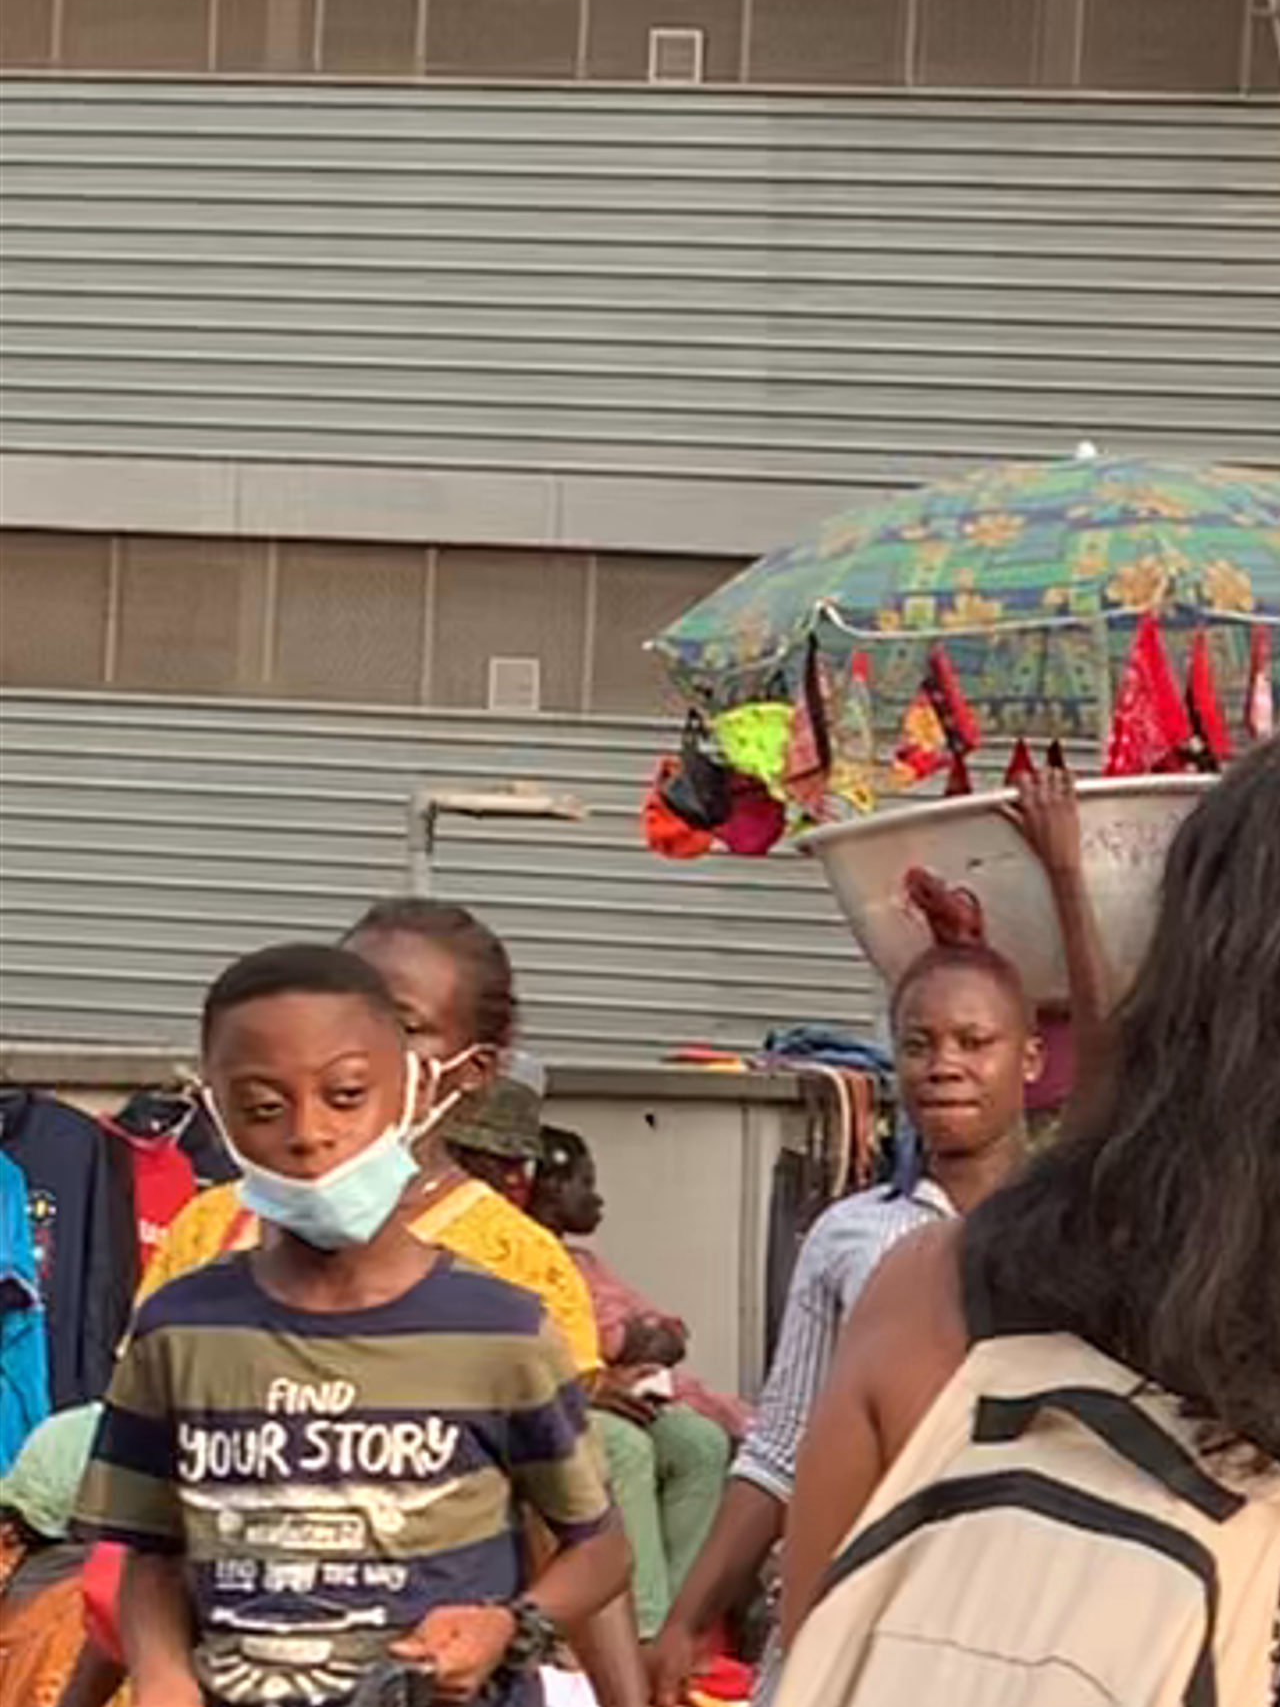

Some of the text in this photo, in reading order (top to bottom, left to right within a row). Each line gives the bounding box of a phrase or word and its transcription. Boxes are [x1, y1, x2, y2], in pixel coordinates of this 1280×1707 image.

[268, 1377, 356, 1414] FIND
[179, 1417, 460, 1481] YOUR STORY
